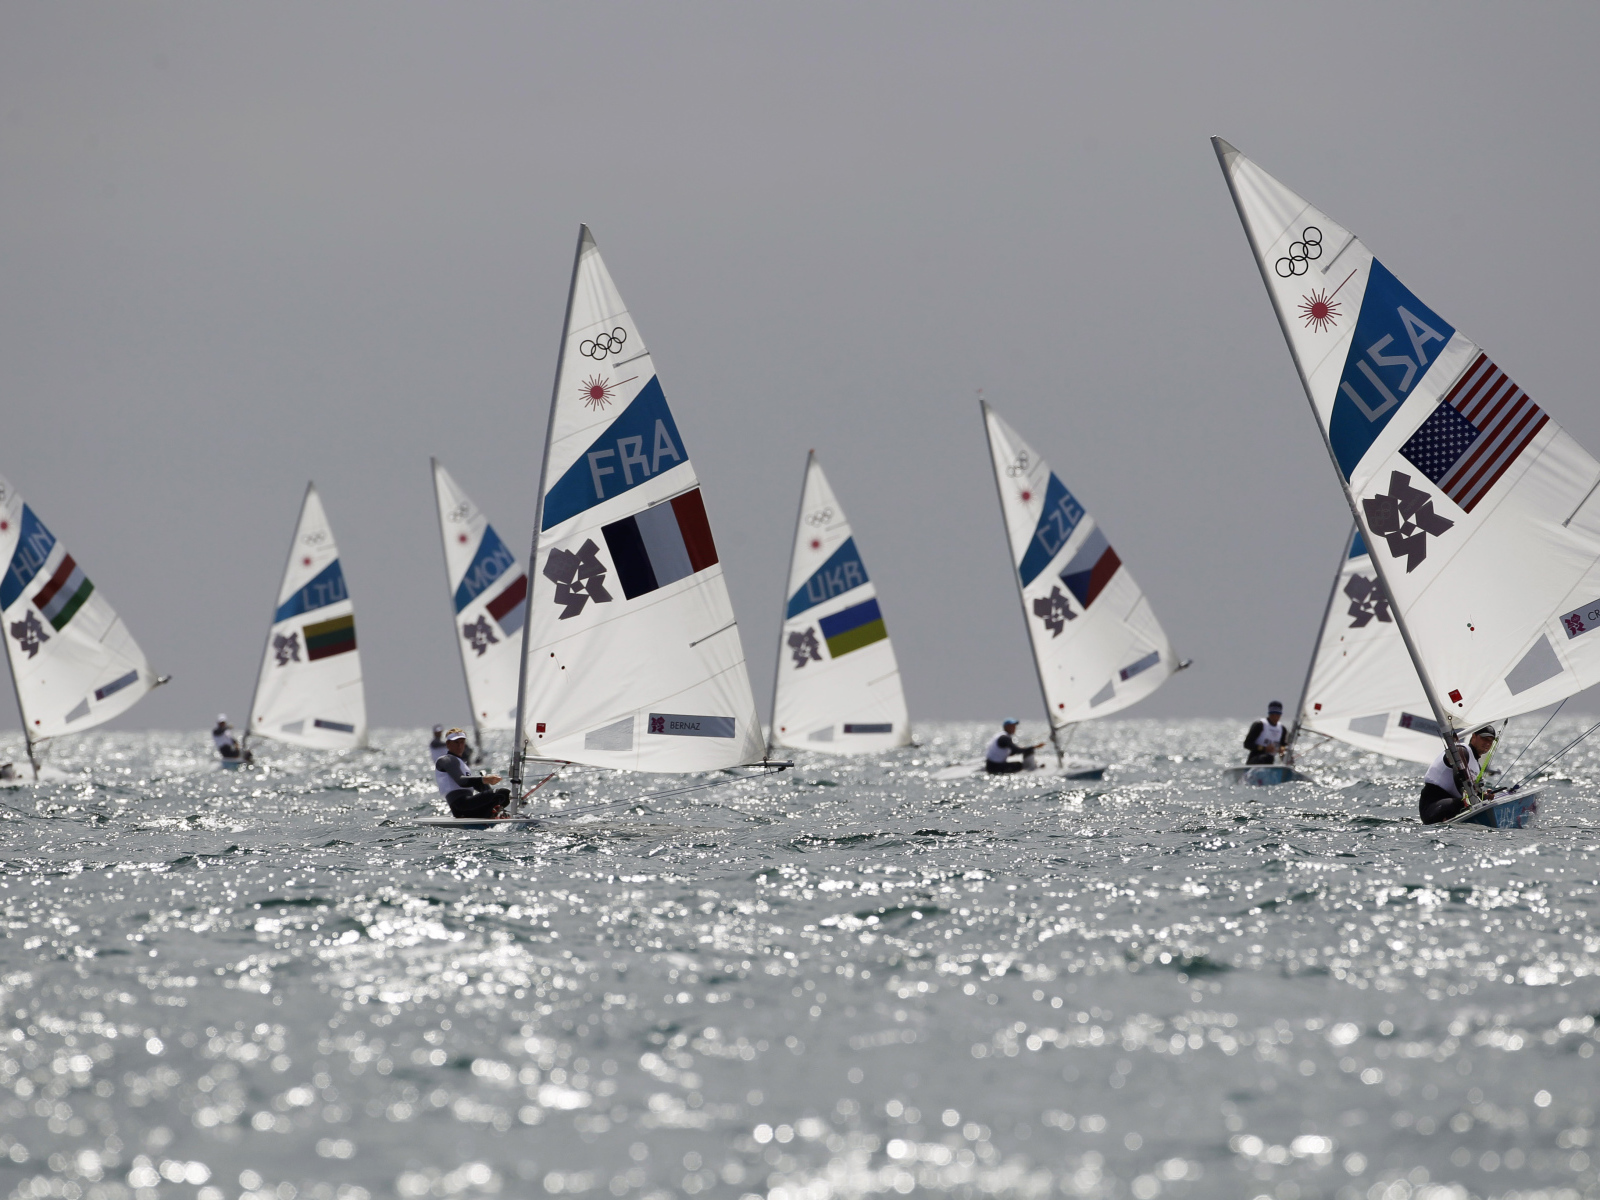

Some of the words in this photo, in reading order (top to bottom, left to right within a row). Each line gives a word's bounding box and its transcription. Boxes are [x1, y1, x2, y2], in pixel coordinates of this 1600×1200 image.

[1340, 305, 1445, 423] USA
[587, 418, 681, 499] FRA
[11, 522, 53, 587] HUN
[1036, 494, 1080, 556] CZE
[302, 577, 344, 611] LTU
[464, 542, 512, 599] MON
[806, 561, 863, 603] UKR
[669, 721, 701, 730] BERNAZ
